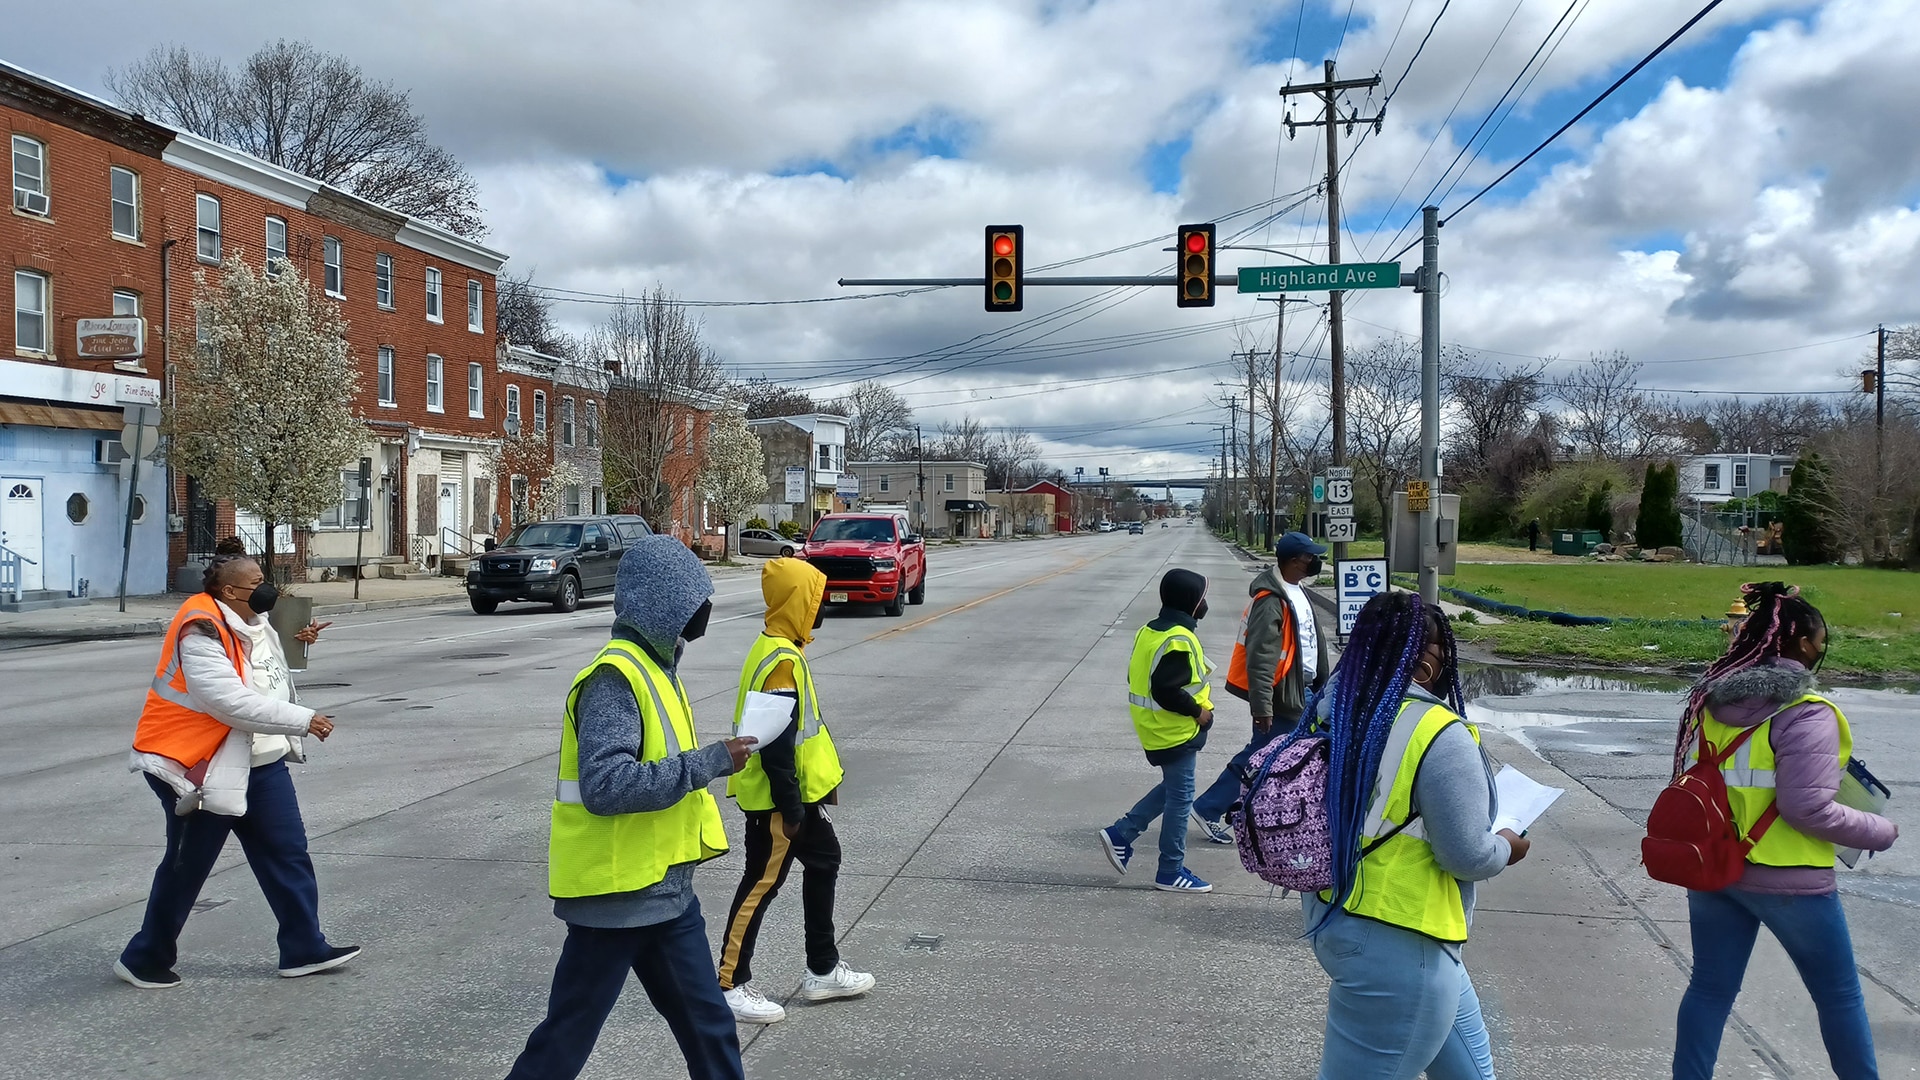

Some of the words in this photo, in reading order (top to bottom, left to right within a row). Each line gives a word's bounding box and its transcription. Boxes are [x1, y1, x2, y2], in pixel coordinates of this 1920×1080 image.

[1260, 269, 1338, 289] Highland
[1345, 268, 1377, 283] Ave
[124, 384, 138, 395] Fine
[1329, 469, 1351, 478] NORTH
[1334, 485, 1348, 498] 13
[1409, 481, 1420, 490] WE
[1331, 507, 1350, 515] EAST
[1329, 524, 1354, 538] 291
[1344, 573, 1358, 588] B
[1366, 573, 1381, 588] C
